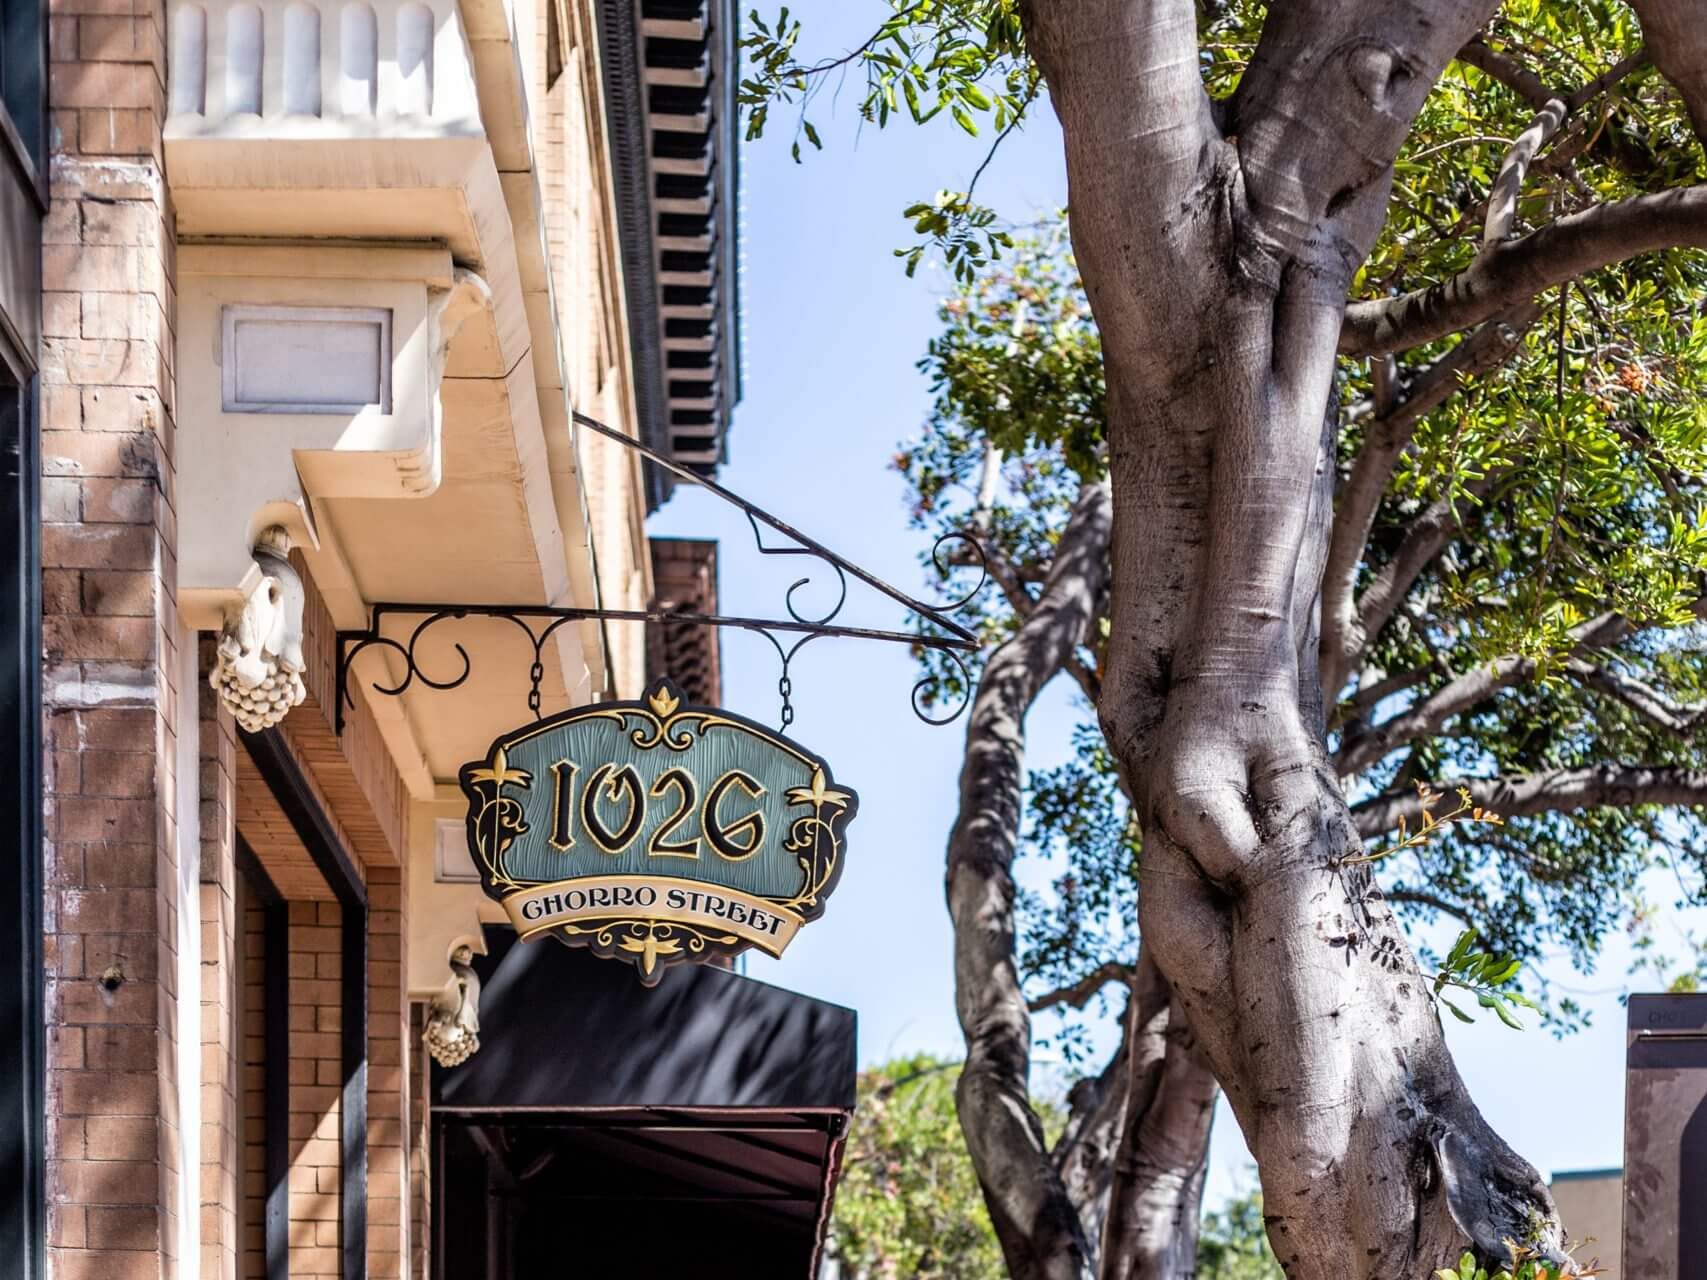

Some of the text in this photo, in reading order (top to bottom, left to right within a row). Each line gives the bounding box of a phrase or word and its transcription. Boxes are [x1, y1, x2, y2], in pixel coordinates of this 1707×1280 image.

[548, 759, 767, 862] 1026
[521, 886, 786, 936] CHORRO STREET
